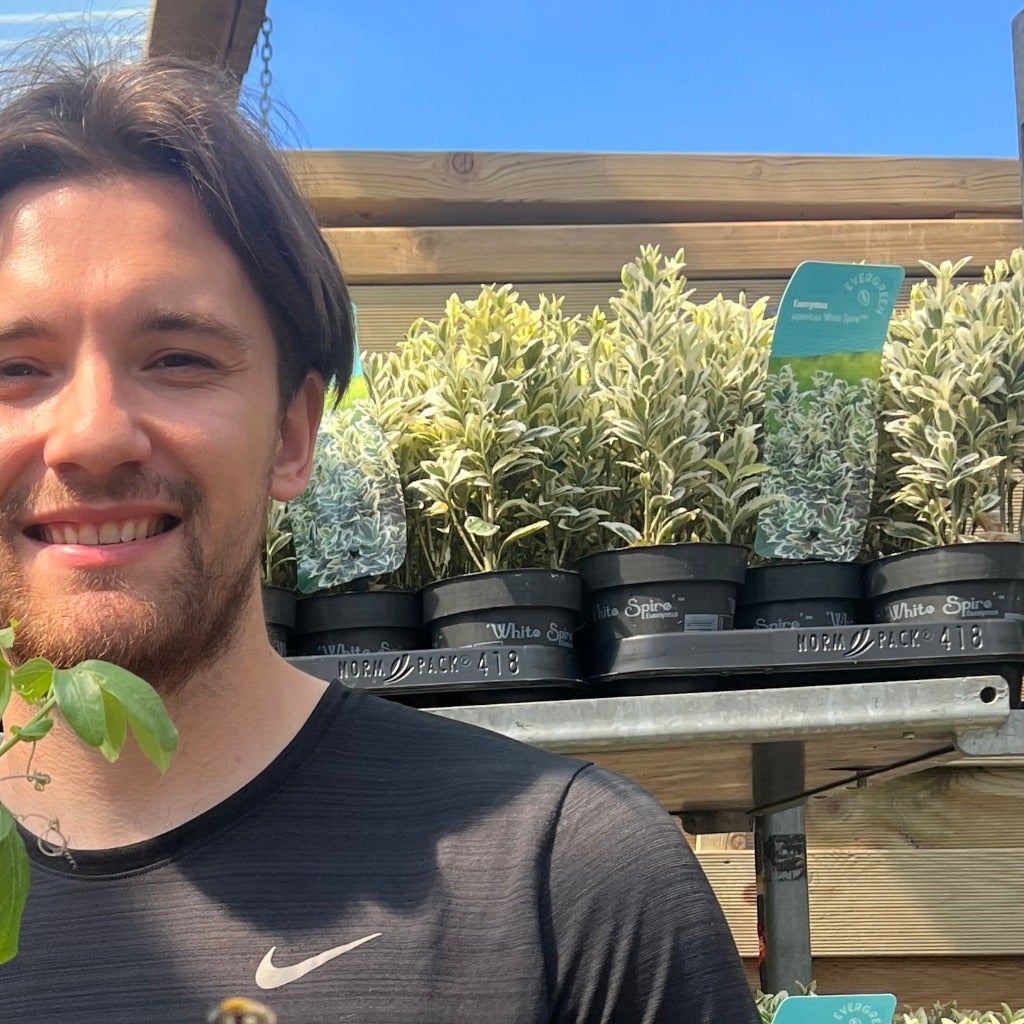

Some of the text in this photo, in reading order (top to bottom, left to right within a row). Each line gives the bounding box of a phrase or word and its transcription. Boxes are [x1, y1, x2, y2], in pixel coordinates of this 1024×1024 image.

[844, 272, 888, 316] EVERGREEN
[595, 603, 619, 620] hite
[940, 624, 984, 651] 418
[478, 650, 520, 677] 418
